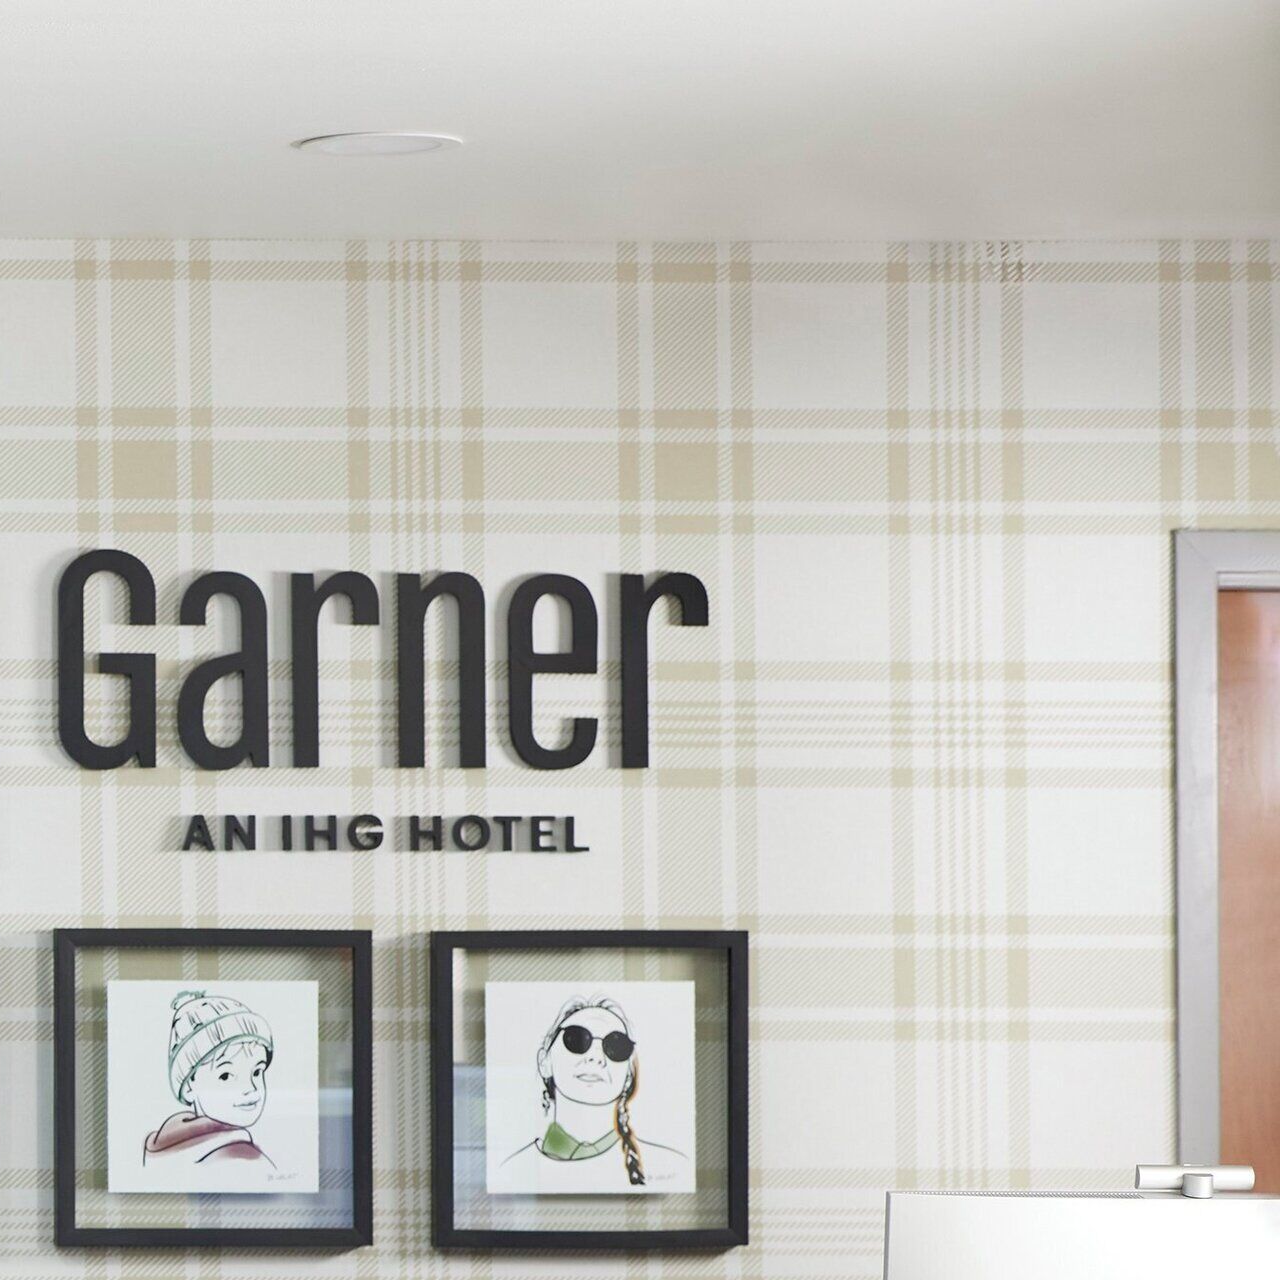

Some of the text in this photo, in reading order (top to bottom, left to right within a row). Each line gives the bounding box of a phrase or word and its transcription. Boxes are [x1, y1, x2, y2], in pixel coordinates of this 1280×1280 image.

[57, 548, 710, 770] Garner
[182, 813, 591, 853] AN IHG HOTEL
